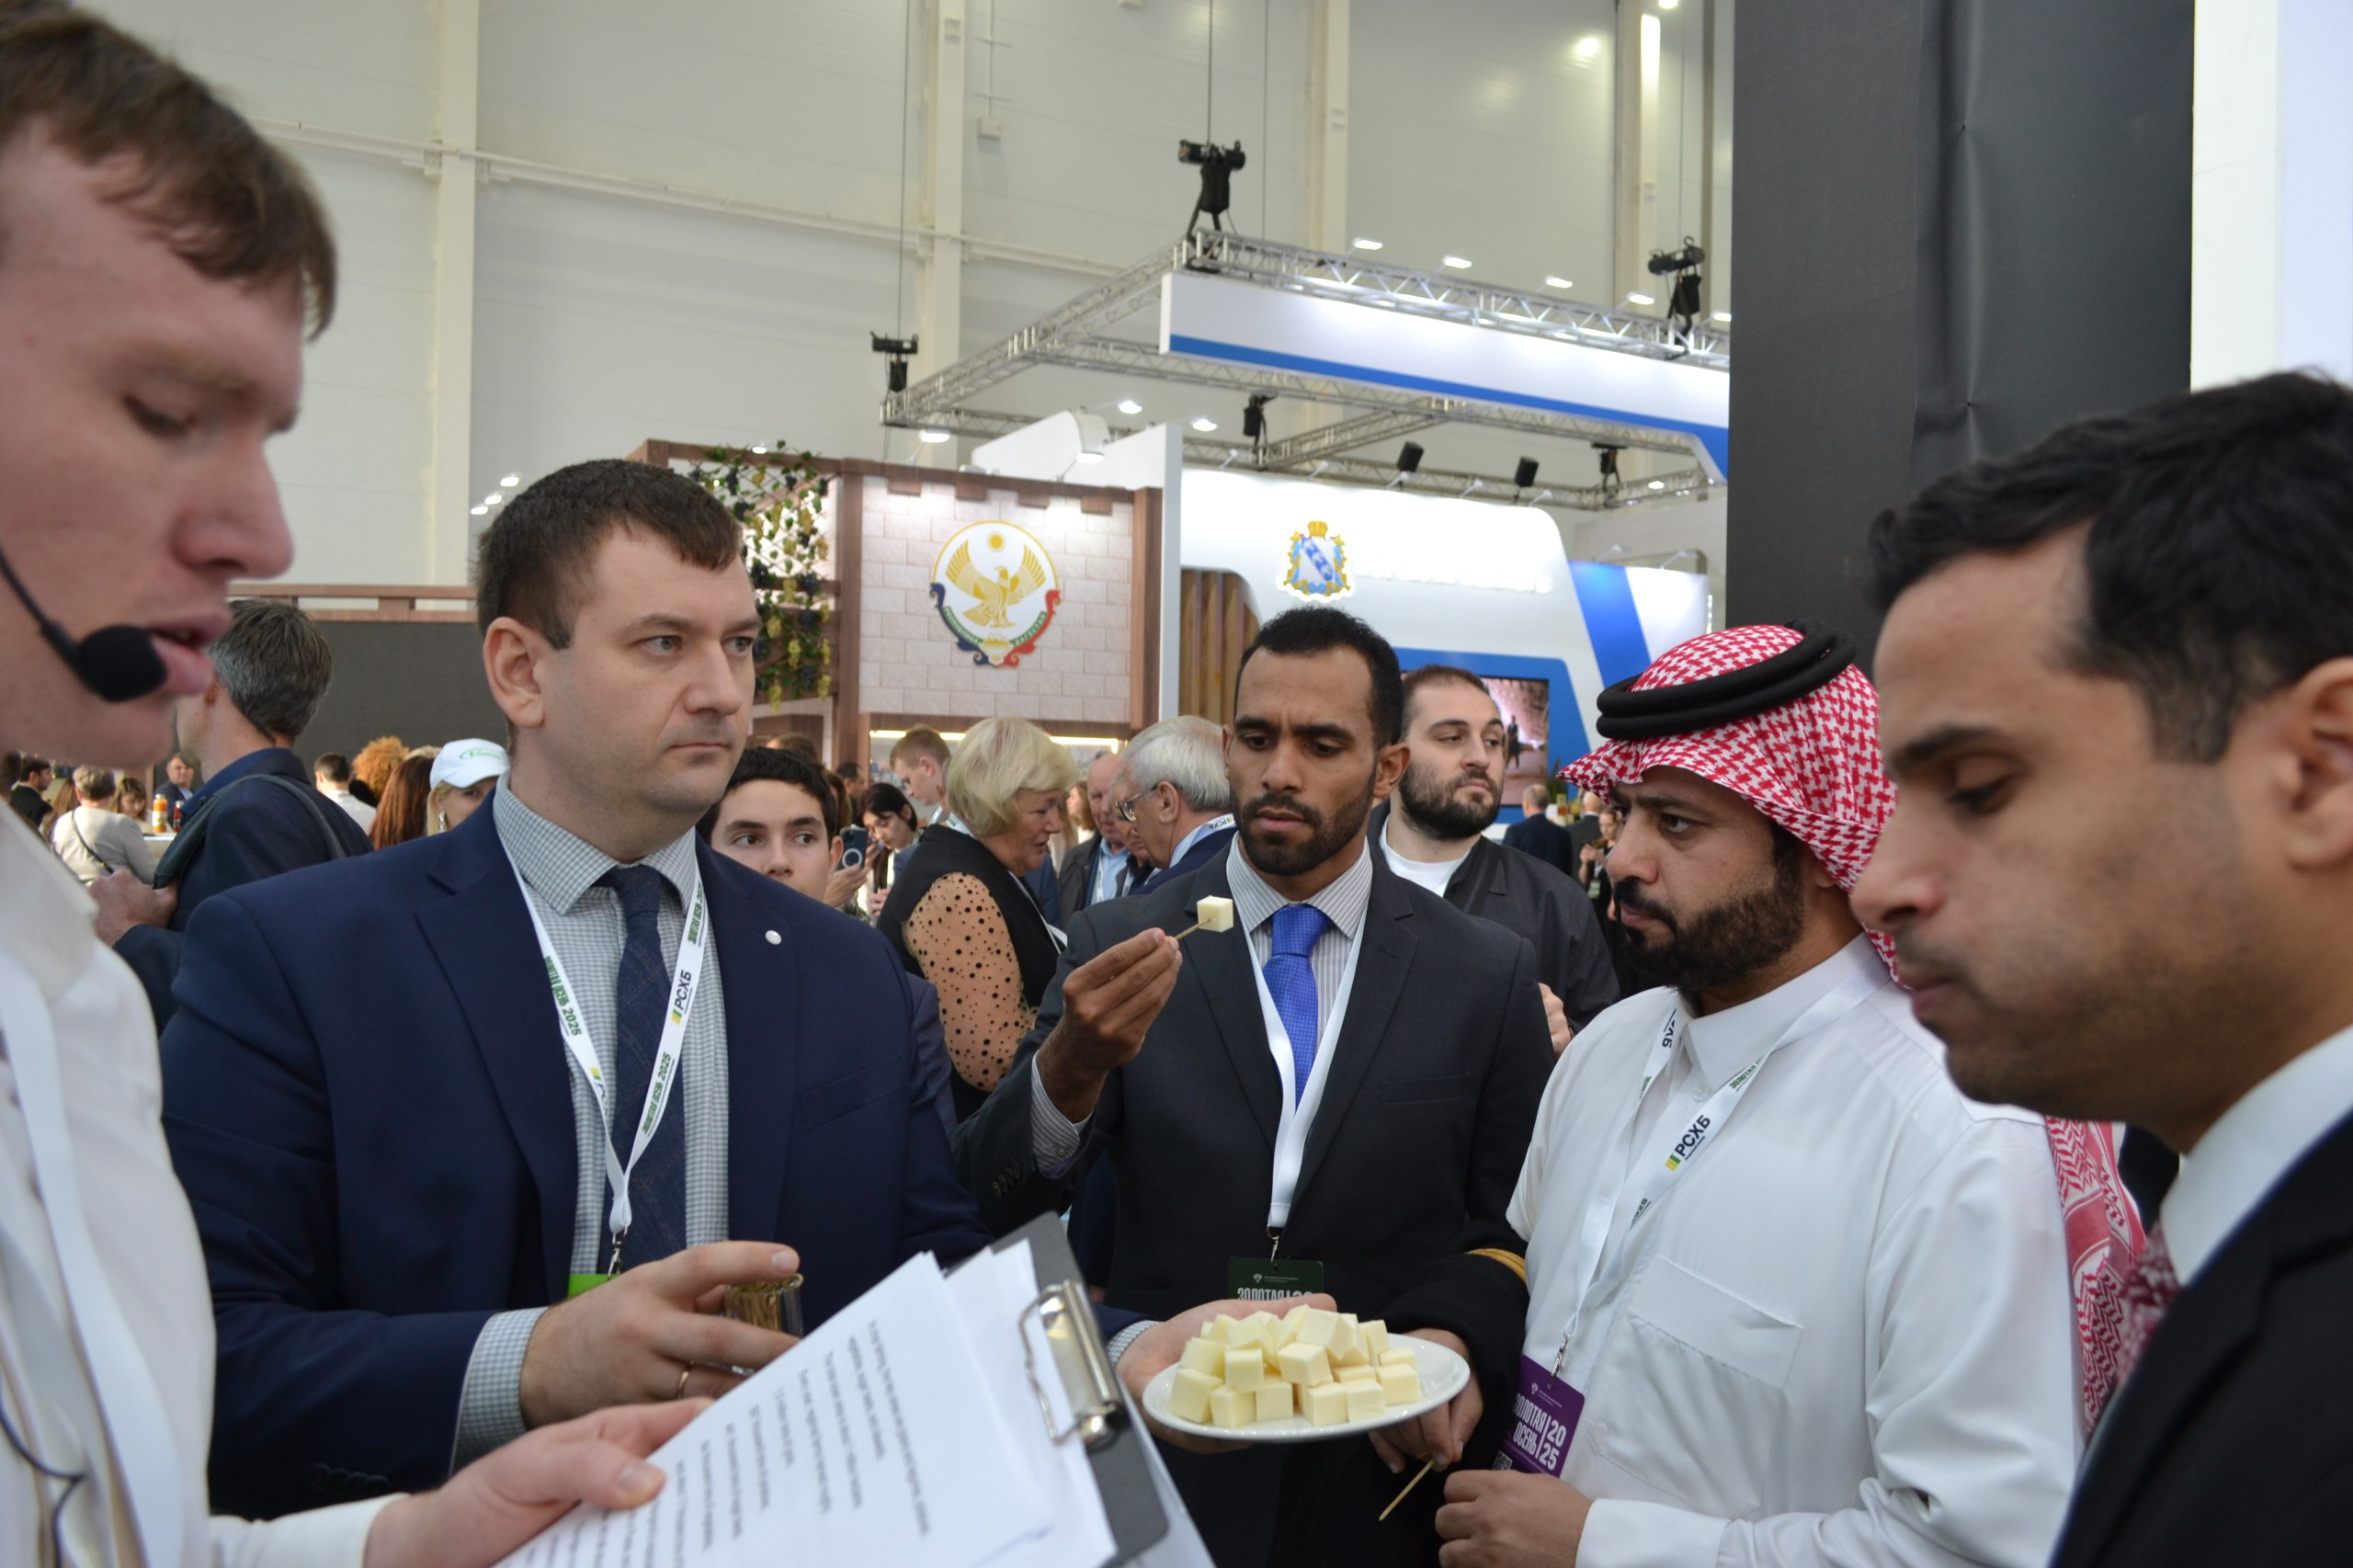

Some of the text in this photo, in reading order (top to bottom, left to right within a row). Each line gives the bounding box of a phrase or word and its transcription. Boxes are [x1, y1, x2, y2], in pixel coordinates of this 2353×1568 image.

[675, 969, 691, 1011] РСХБ
[563, 1008, 582, 1036] 2025
[658, 1051, 671, 1081] 2025
[1674, 1114, 1711, 1158] РСХБ
[1513, 1421, 1539, 1456] ОСЕНЬ
[1546, 1419, 1567, 1448] 20
[1539, 1442, 1560, 1471] 25
